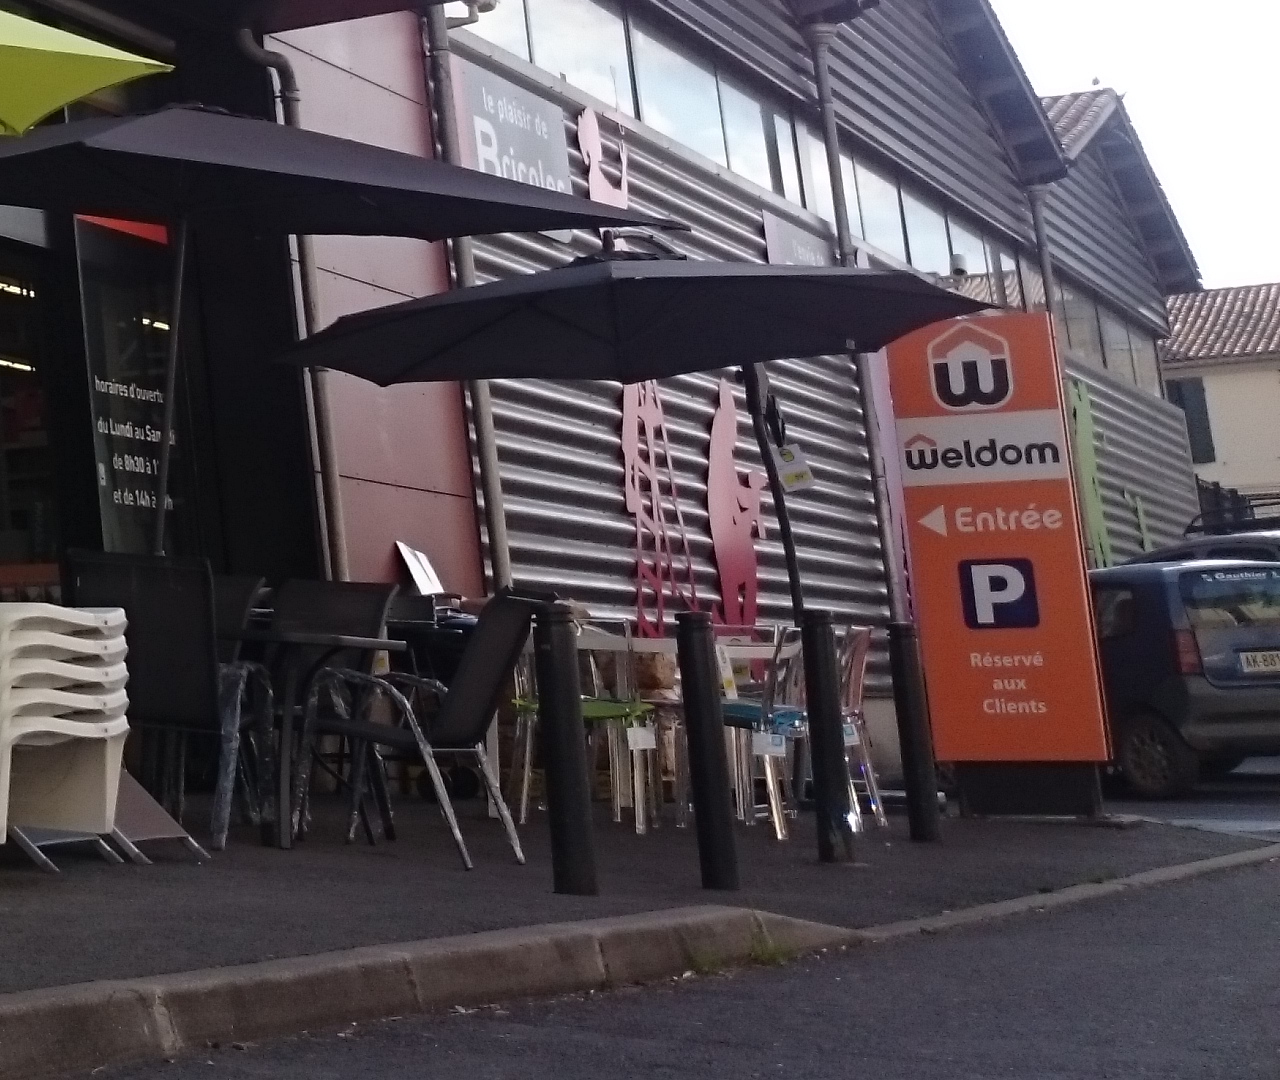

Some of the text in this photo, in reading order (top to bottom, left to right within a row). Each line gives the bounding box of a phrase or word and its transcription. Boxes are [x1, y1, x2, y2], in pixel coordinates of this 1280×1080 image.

[497, 97, 531, 131] plaisir
[535, 113, 548, 139] de
[94, 375, 128, 396] horaires
[97, 417, 109, 434] du
[109, 418, 133, 438] Lundi
[134, 426, 145, 440] au
[112, 453, 123, 470] de
[124, 454, 145, 473] 8h30
[113, 489, 122, 503] et
[123, 488, 134, 505] de
[954, 503, 1063, 533] Entrée
[1214, 571, 1267, 580] Gauthier
[970, 564, 1025, 624] P
[970, 652, 1044, 668] Réservé
[993, 678, 1027, 690] aux
[983, 698, 1048, 714] Clients
